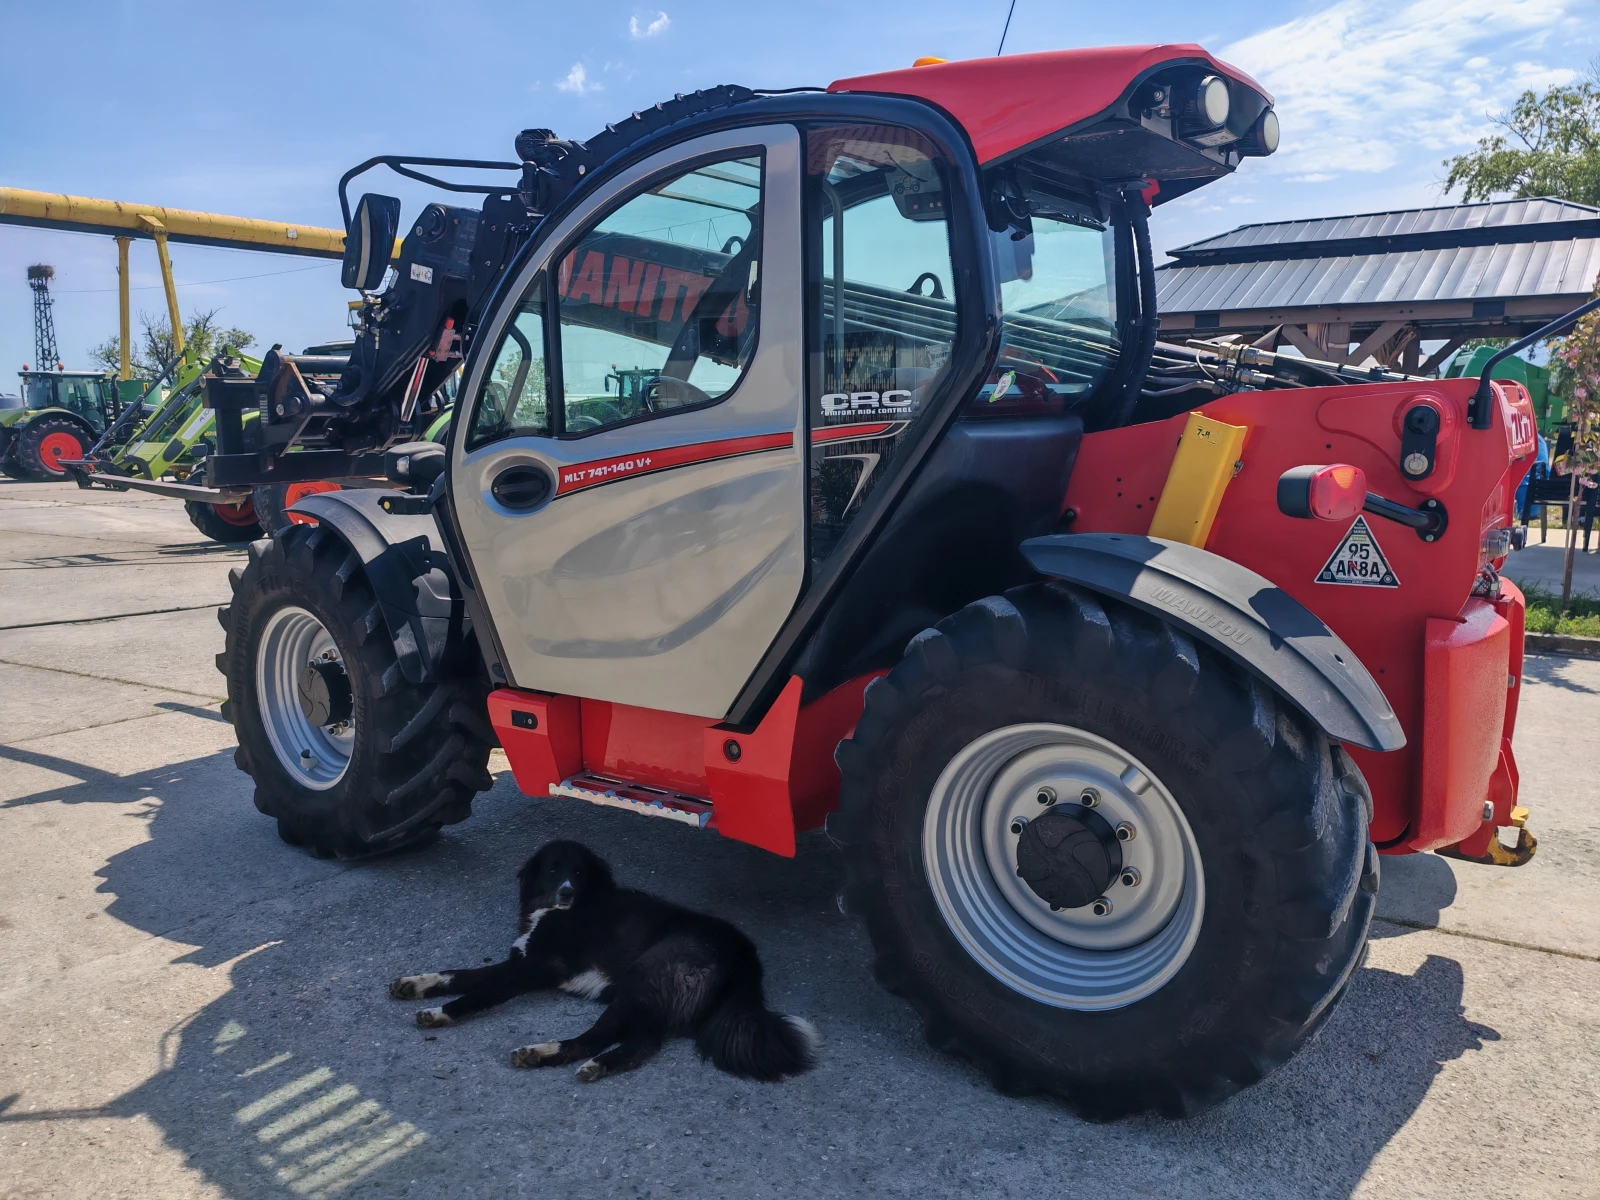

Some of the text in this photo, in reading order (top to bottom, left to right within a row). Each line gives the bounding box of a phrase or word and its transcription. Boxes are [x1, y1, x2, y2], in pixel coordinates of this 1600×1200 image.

[820, 389, 912, 410] CRC
[564, 457, 652, 484] MLT 741-140 V+
[1348, 543, 1370, 560] 95
[1150, 587, 1252, 646] MANITOU
[873, 749, 913, 836] 400
[900, 686, 972, 752] AGRO
